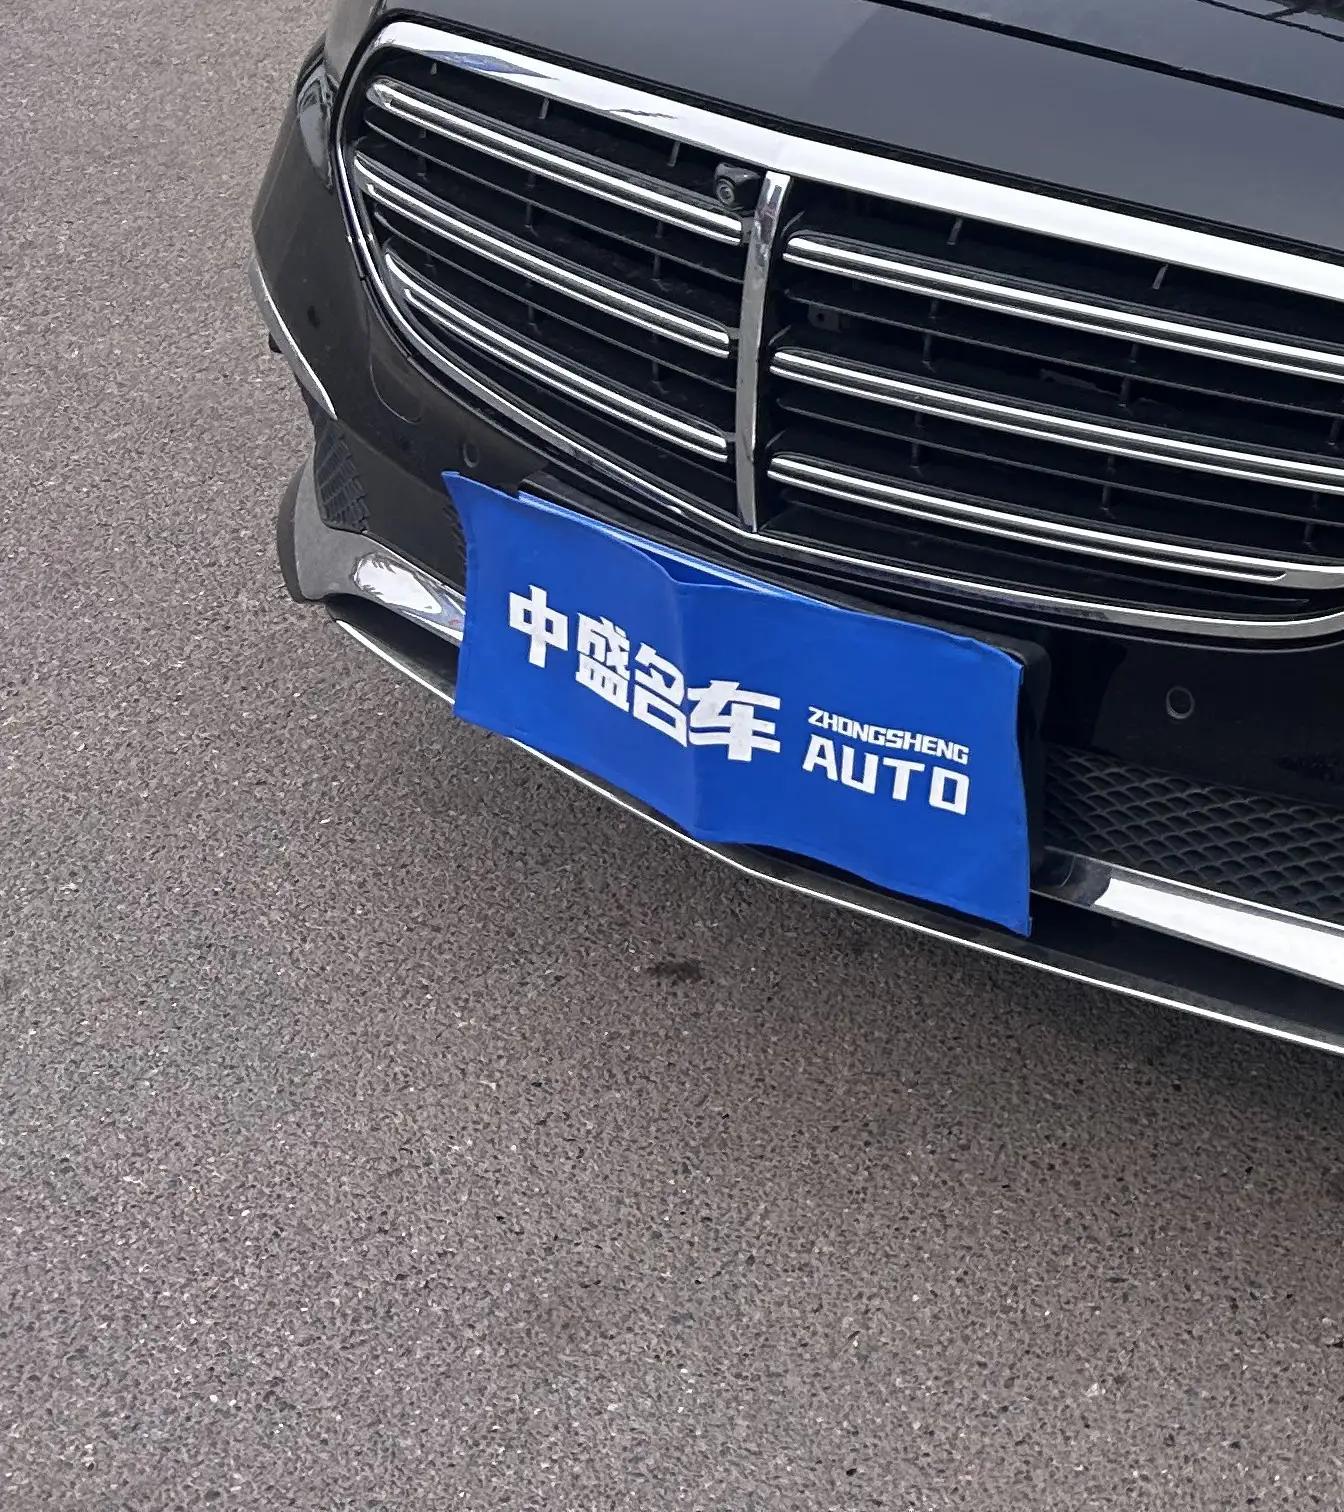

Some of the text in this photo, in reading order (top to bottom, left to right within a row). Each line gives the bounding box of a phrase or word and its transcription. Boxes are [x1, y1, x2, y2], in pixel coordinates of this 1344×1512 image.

[508, 584, 781, 763] 中盛名车
[802, 734, 970, 816] AUTO
[807, 705, 970, 765] ZHONGSHENG
